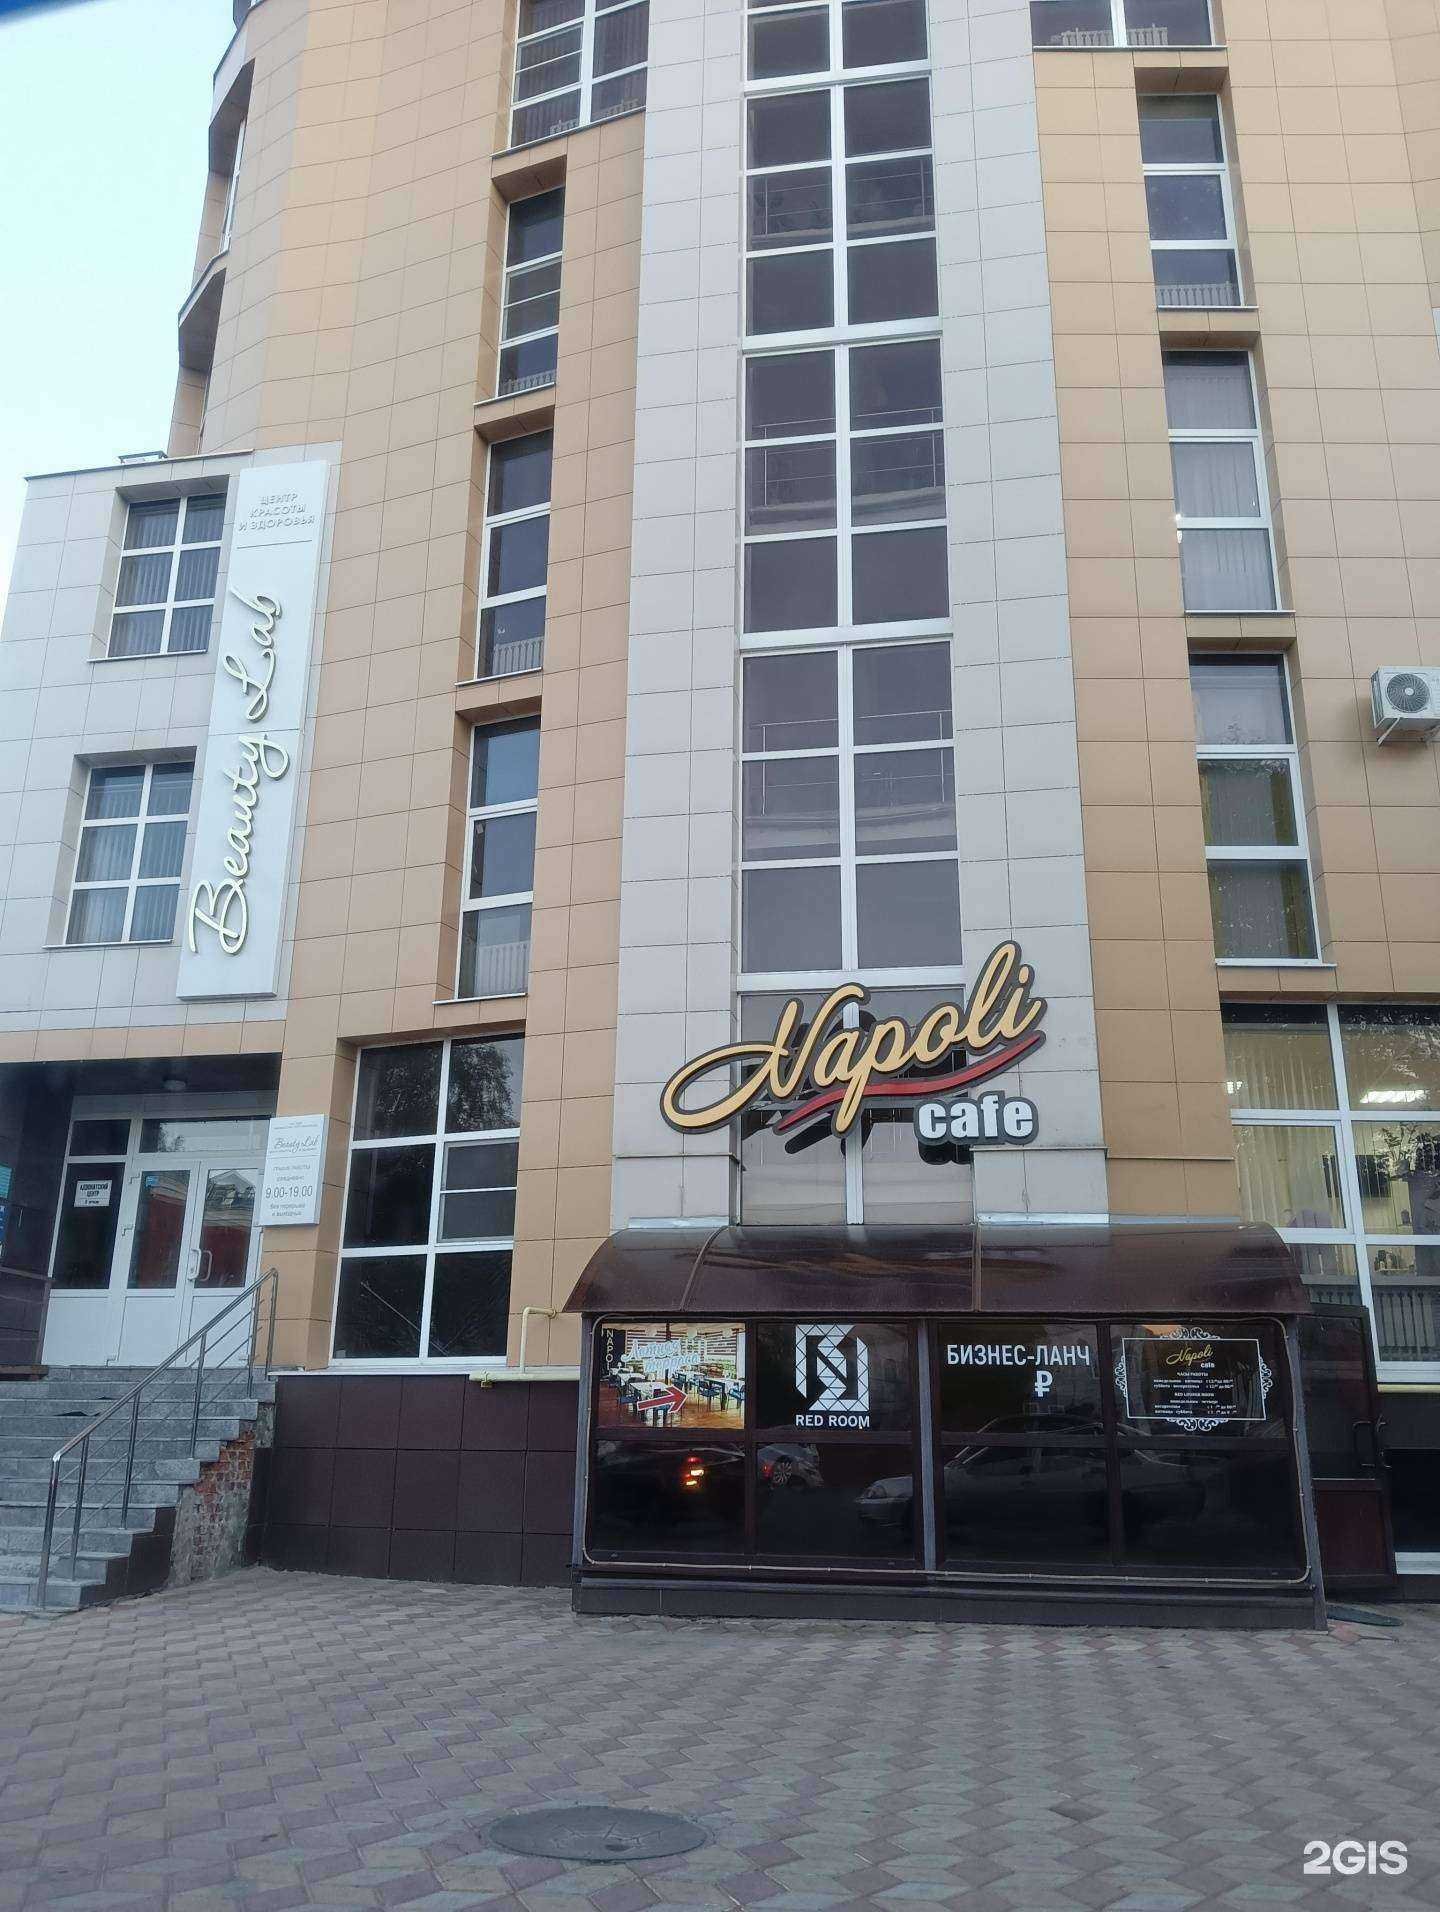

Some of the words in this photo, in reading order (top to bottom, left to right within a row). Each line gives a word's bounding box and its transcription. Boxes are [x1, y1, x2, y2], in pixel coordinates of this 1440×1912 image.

[260, 493, 298, 505] ЦЕНТР
[250, 505, 306, 518] КРАСОТЫ
[238, 521, 248, 531] И
[249, 515, 315, 531] ЗДОРОВЬЯ
[223, 586, 282, 722] Lab
[188, 733, 290, 955] Beauty
[661, 941, 1046, 1132] Napoli
[916, 1092, 1037, 1144] cafe
[947, 1344, 1090, 1366] БИЗНЕС-ЛАНЧ
[1166, 1344, 1214, 1366] Napoli
[795, 1415, 824, 1427] RED
[828, 1415, 870, 1427] ROOM
